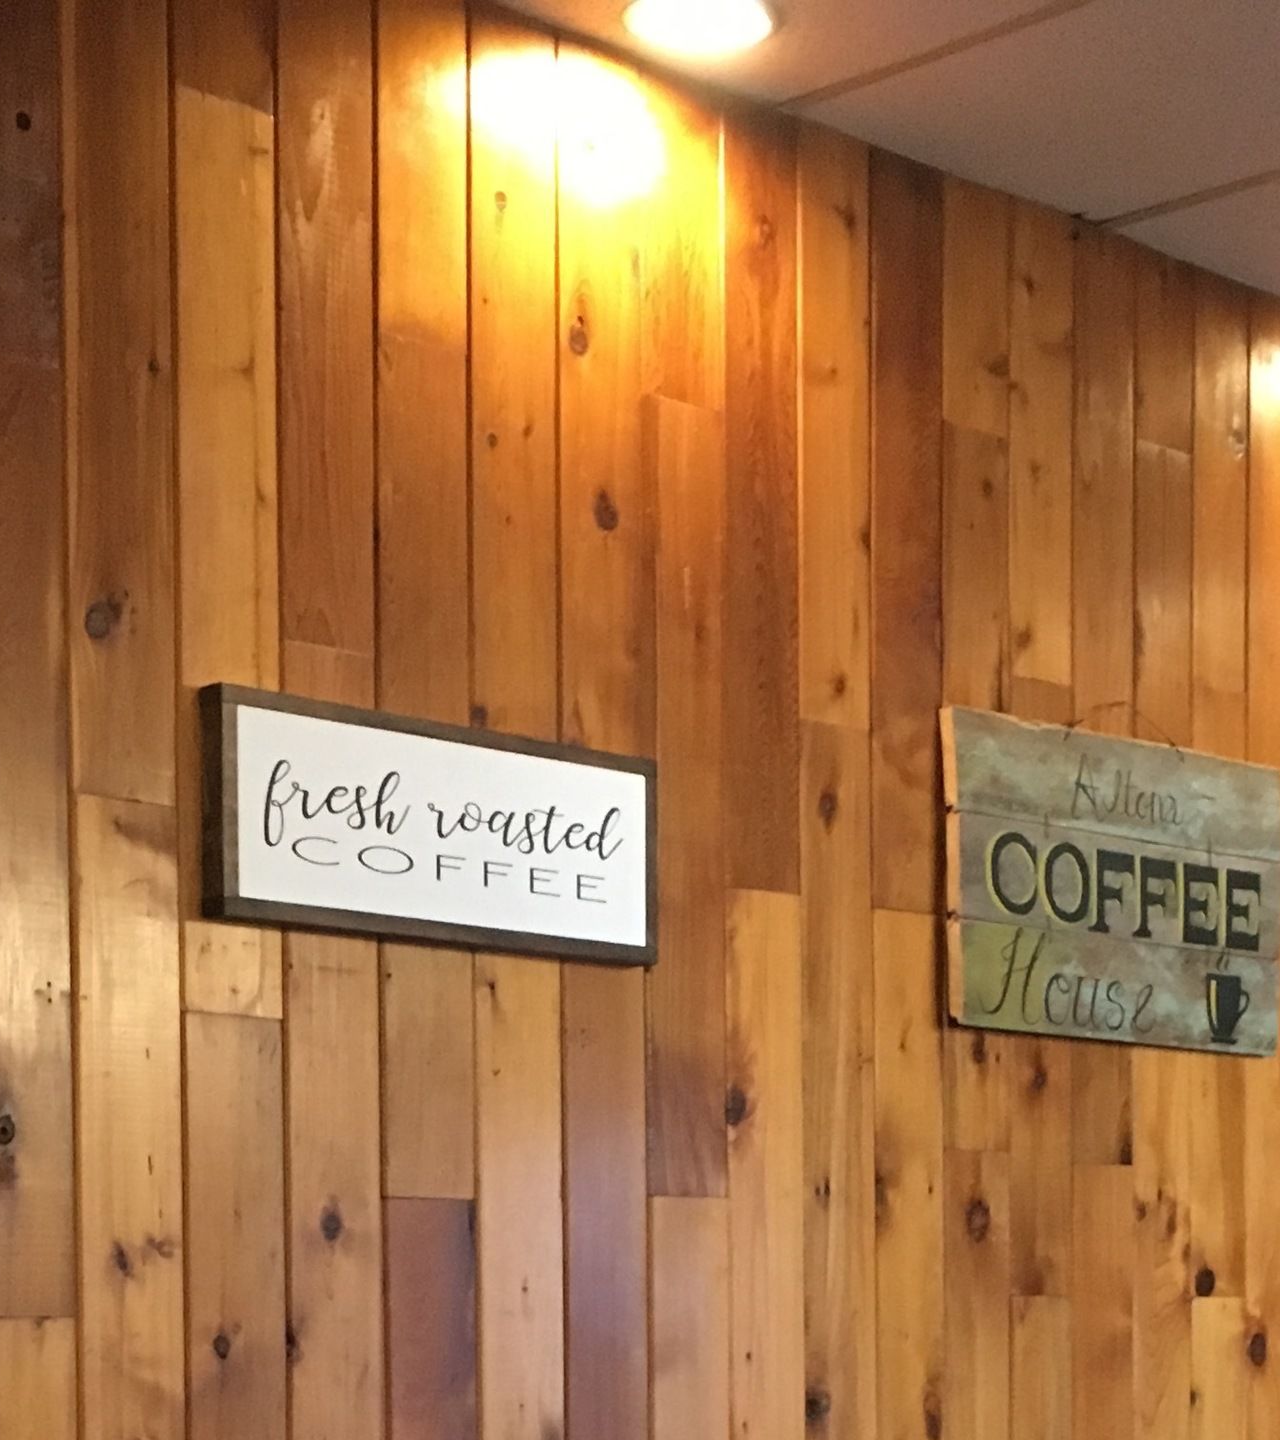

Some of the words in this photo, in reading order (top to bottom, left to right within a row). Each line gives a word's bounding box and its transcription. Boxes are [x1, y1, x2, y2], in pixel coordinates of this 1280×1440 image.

[264, 758, 411, 848] fresh
[427, 801, 624, 862] roasted
[291, 836, 608, 904] COFFEE
[985, 830, 1262, 952] COFFEE
[980, 927, 1160, 1034] House
